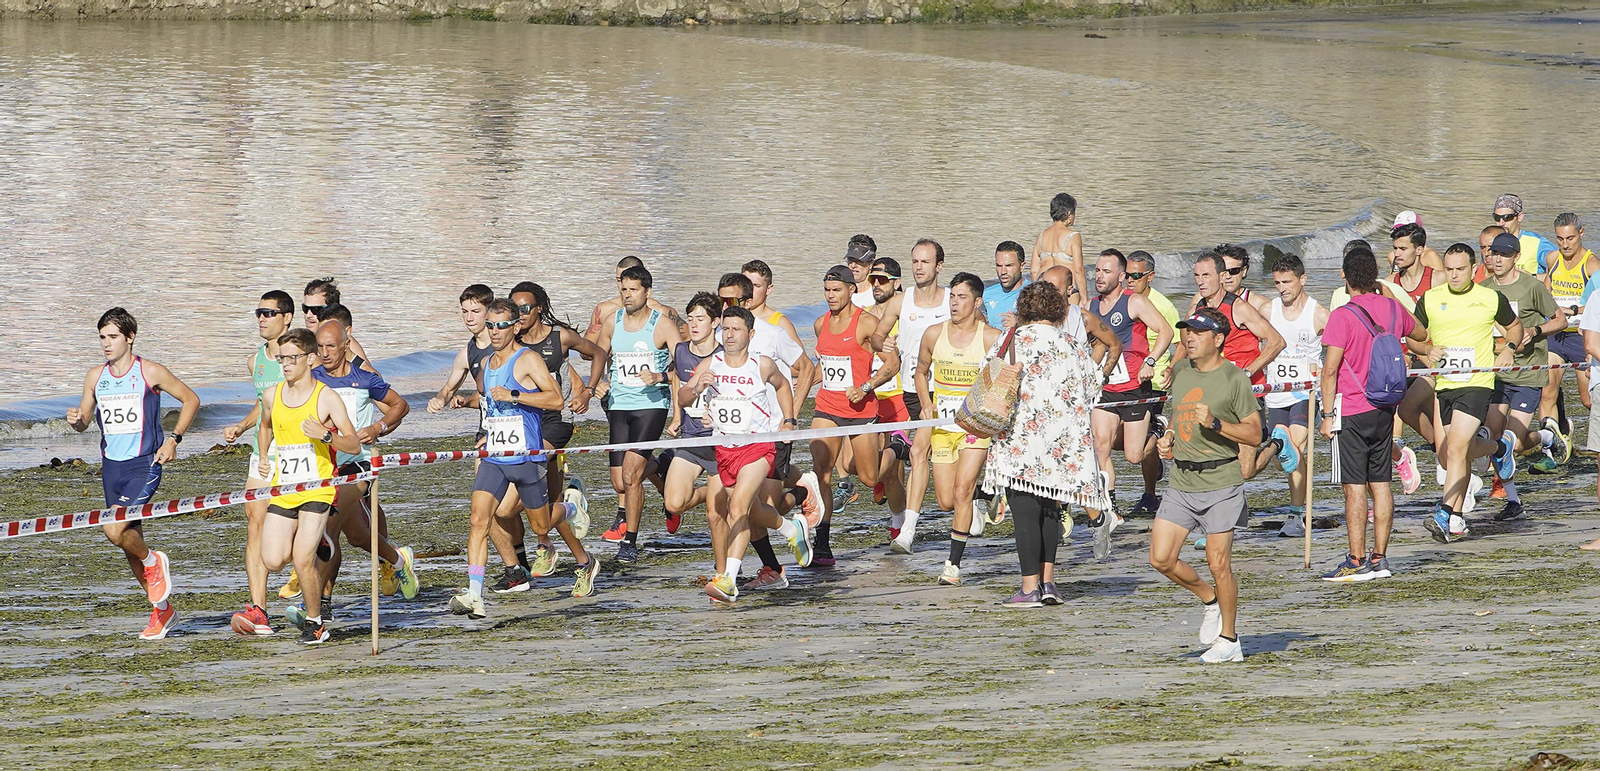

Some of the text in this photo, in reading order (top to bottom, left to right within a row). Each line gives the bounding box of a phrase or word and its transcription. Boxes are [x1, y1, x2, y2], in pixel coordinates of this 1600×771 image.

[824, 367, 847, 382] 199
[939, 368, 978, 378] ATHLETICS
[1277, 364, 1299, 379] 85
[103, 407, 139, 425] 256
[718, 408, 742, 425] 88
[490, 429, 520, 446] 146
[281, 457, 310, 475] 271
